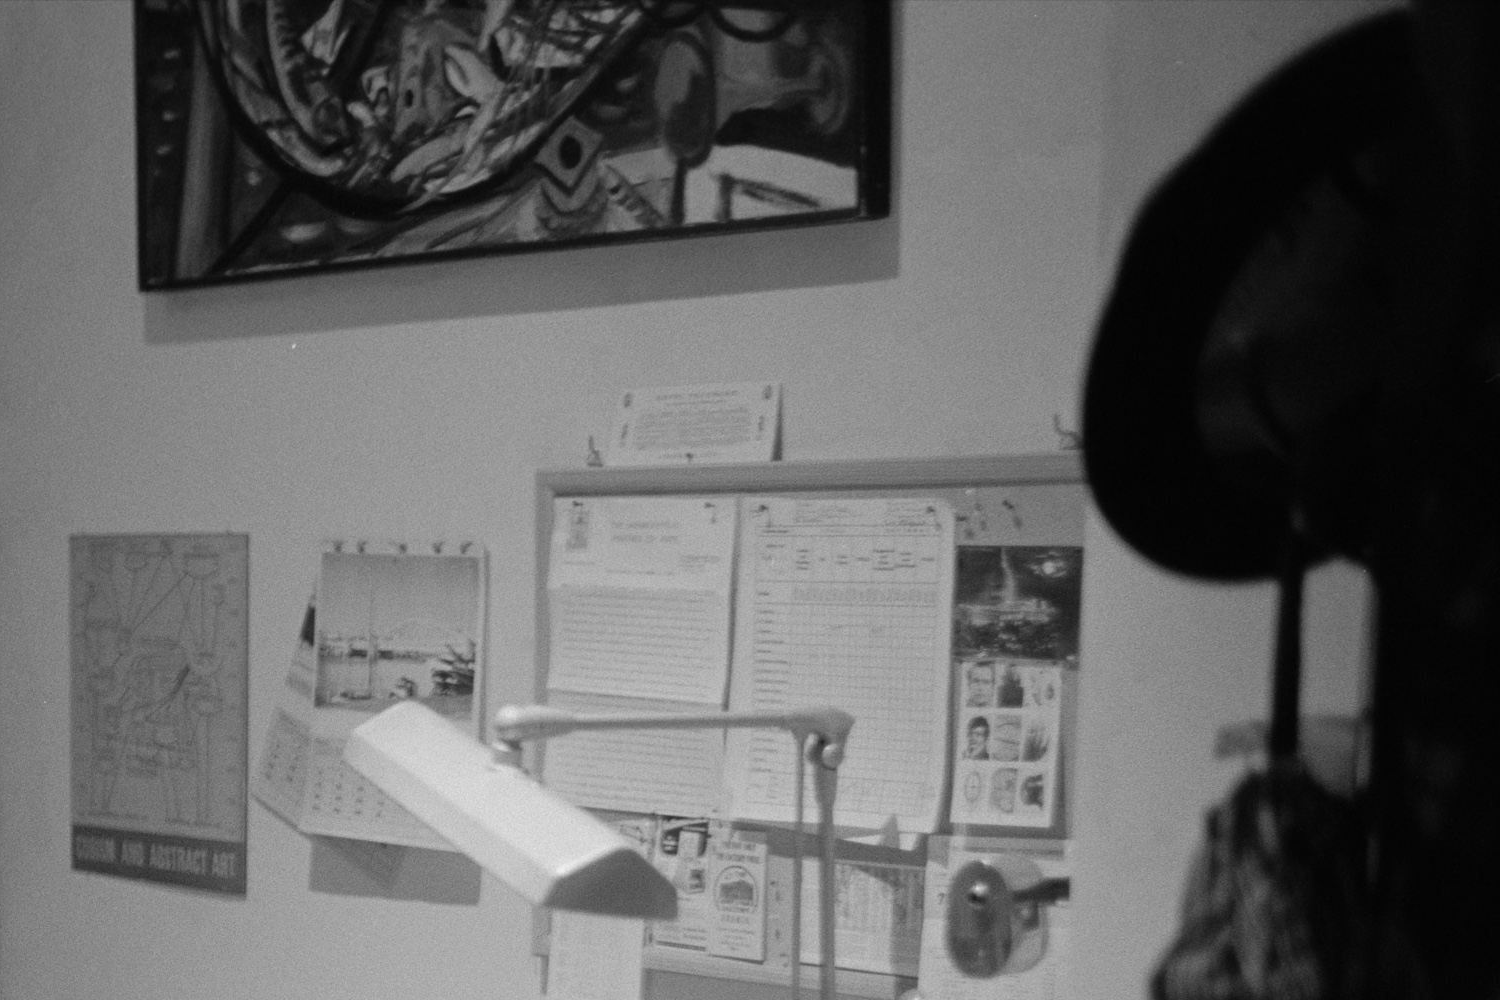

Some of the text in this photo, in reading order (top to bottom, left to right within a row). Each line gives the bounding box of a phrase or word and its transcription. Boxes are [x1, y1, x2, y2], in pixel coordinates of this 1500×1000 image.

[121, 839, 145, 867] AND
[150, 843, 208, 876] ABSTRACT
[212, 850, 237, 879] ART
